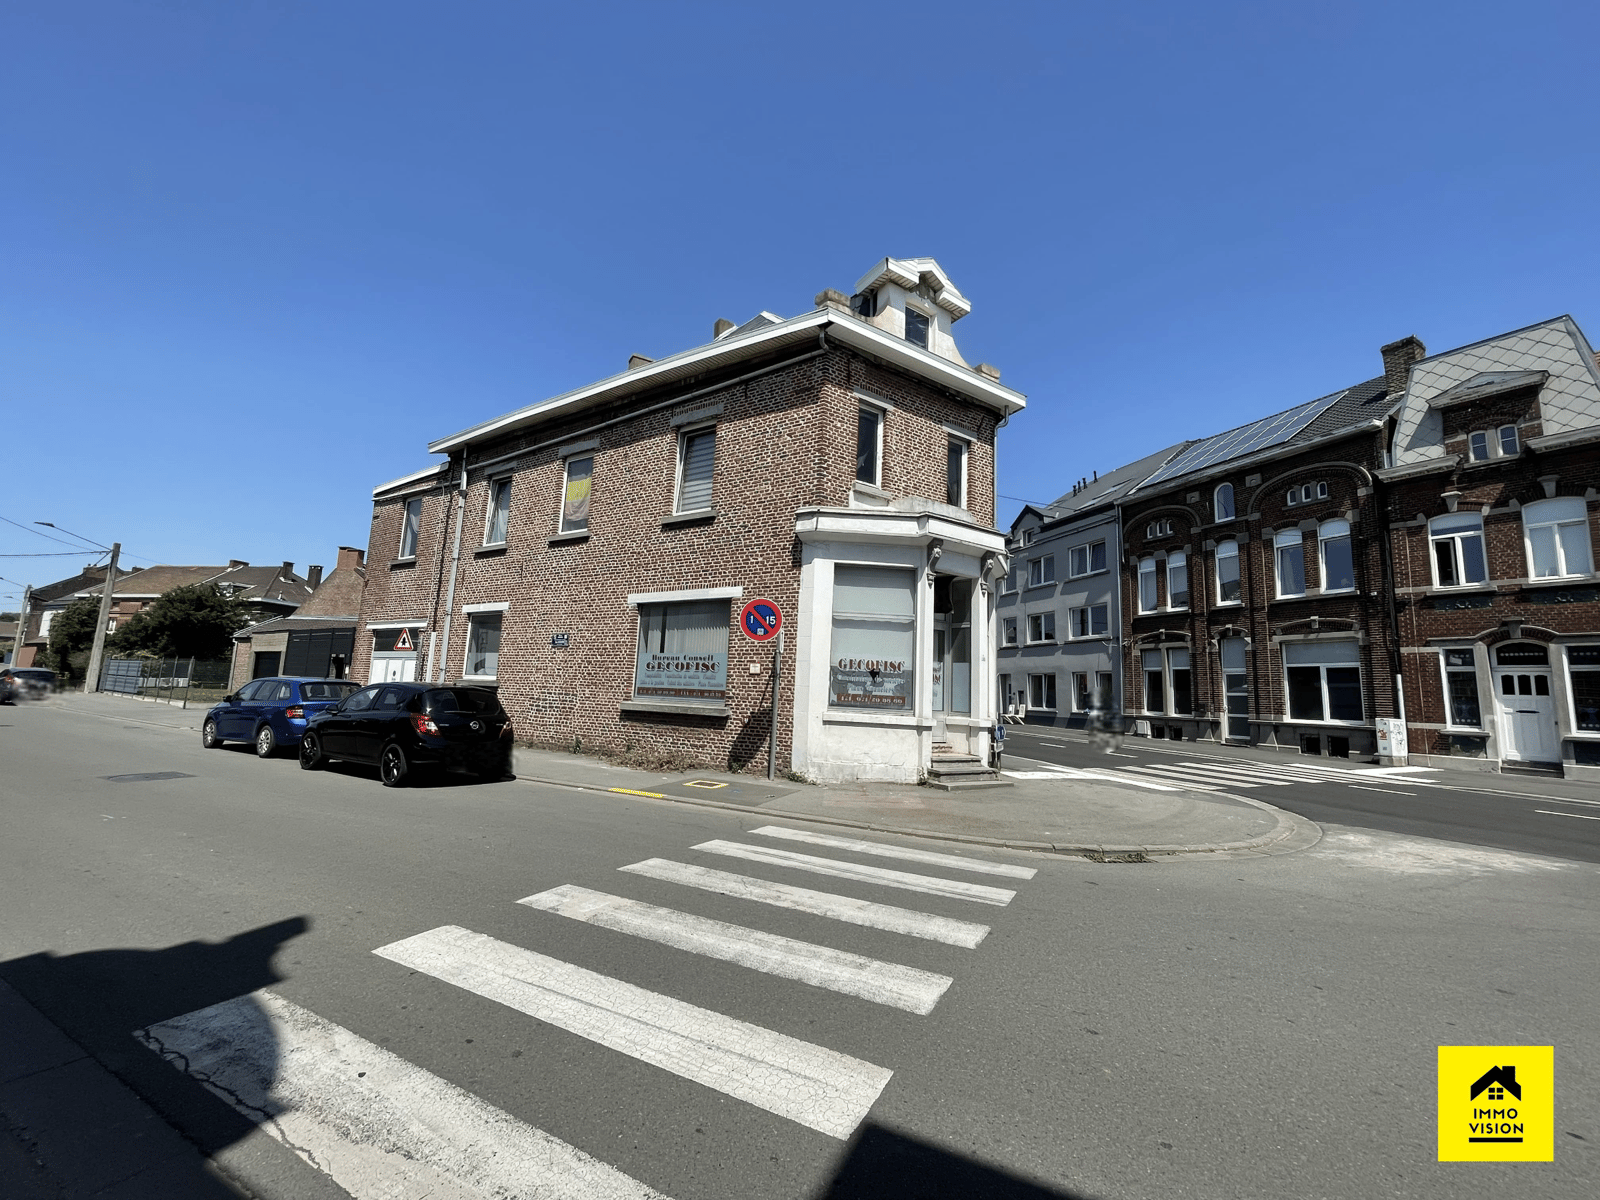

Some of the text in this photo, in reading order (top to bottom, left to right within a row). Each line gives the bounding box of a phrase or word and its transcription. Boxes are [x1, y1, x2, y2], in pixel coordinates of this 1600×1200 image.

[750, 615, 776, 625] 1 15
[645, 661, 720, 673] GECOFISC
[838, 658, 906, 673] GECOFISC
